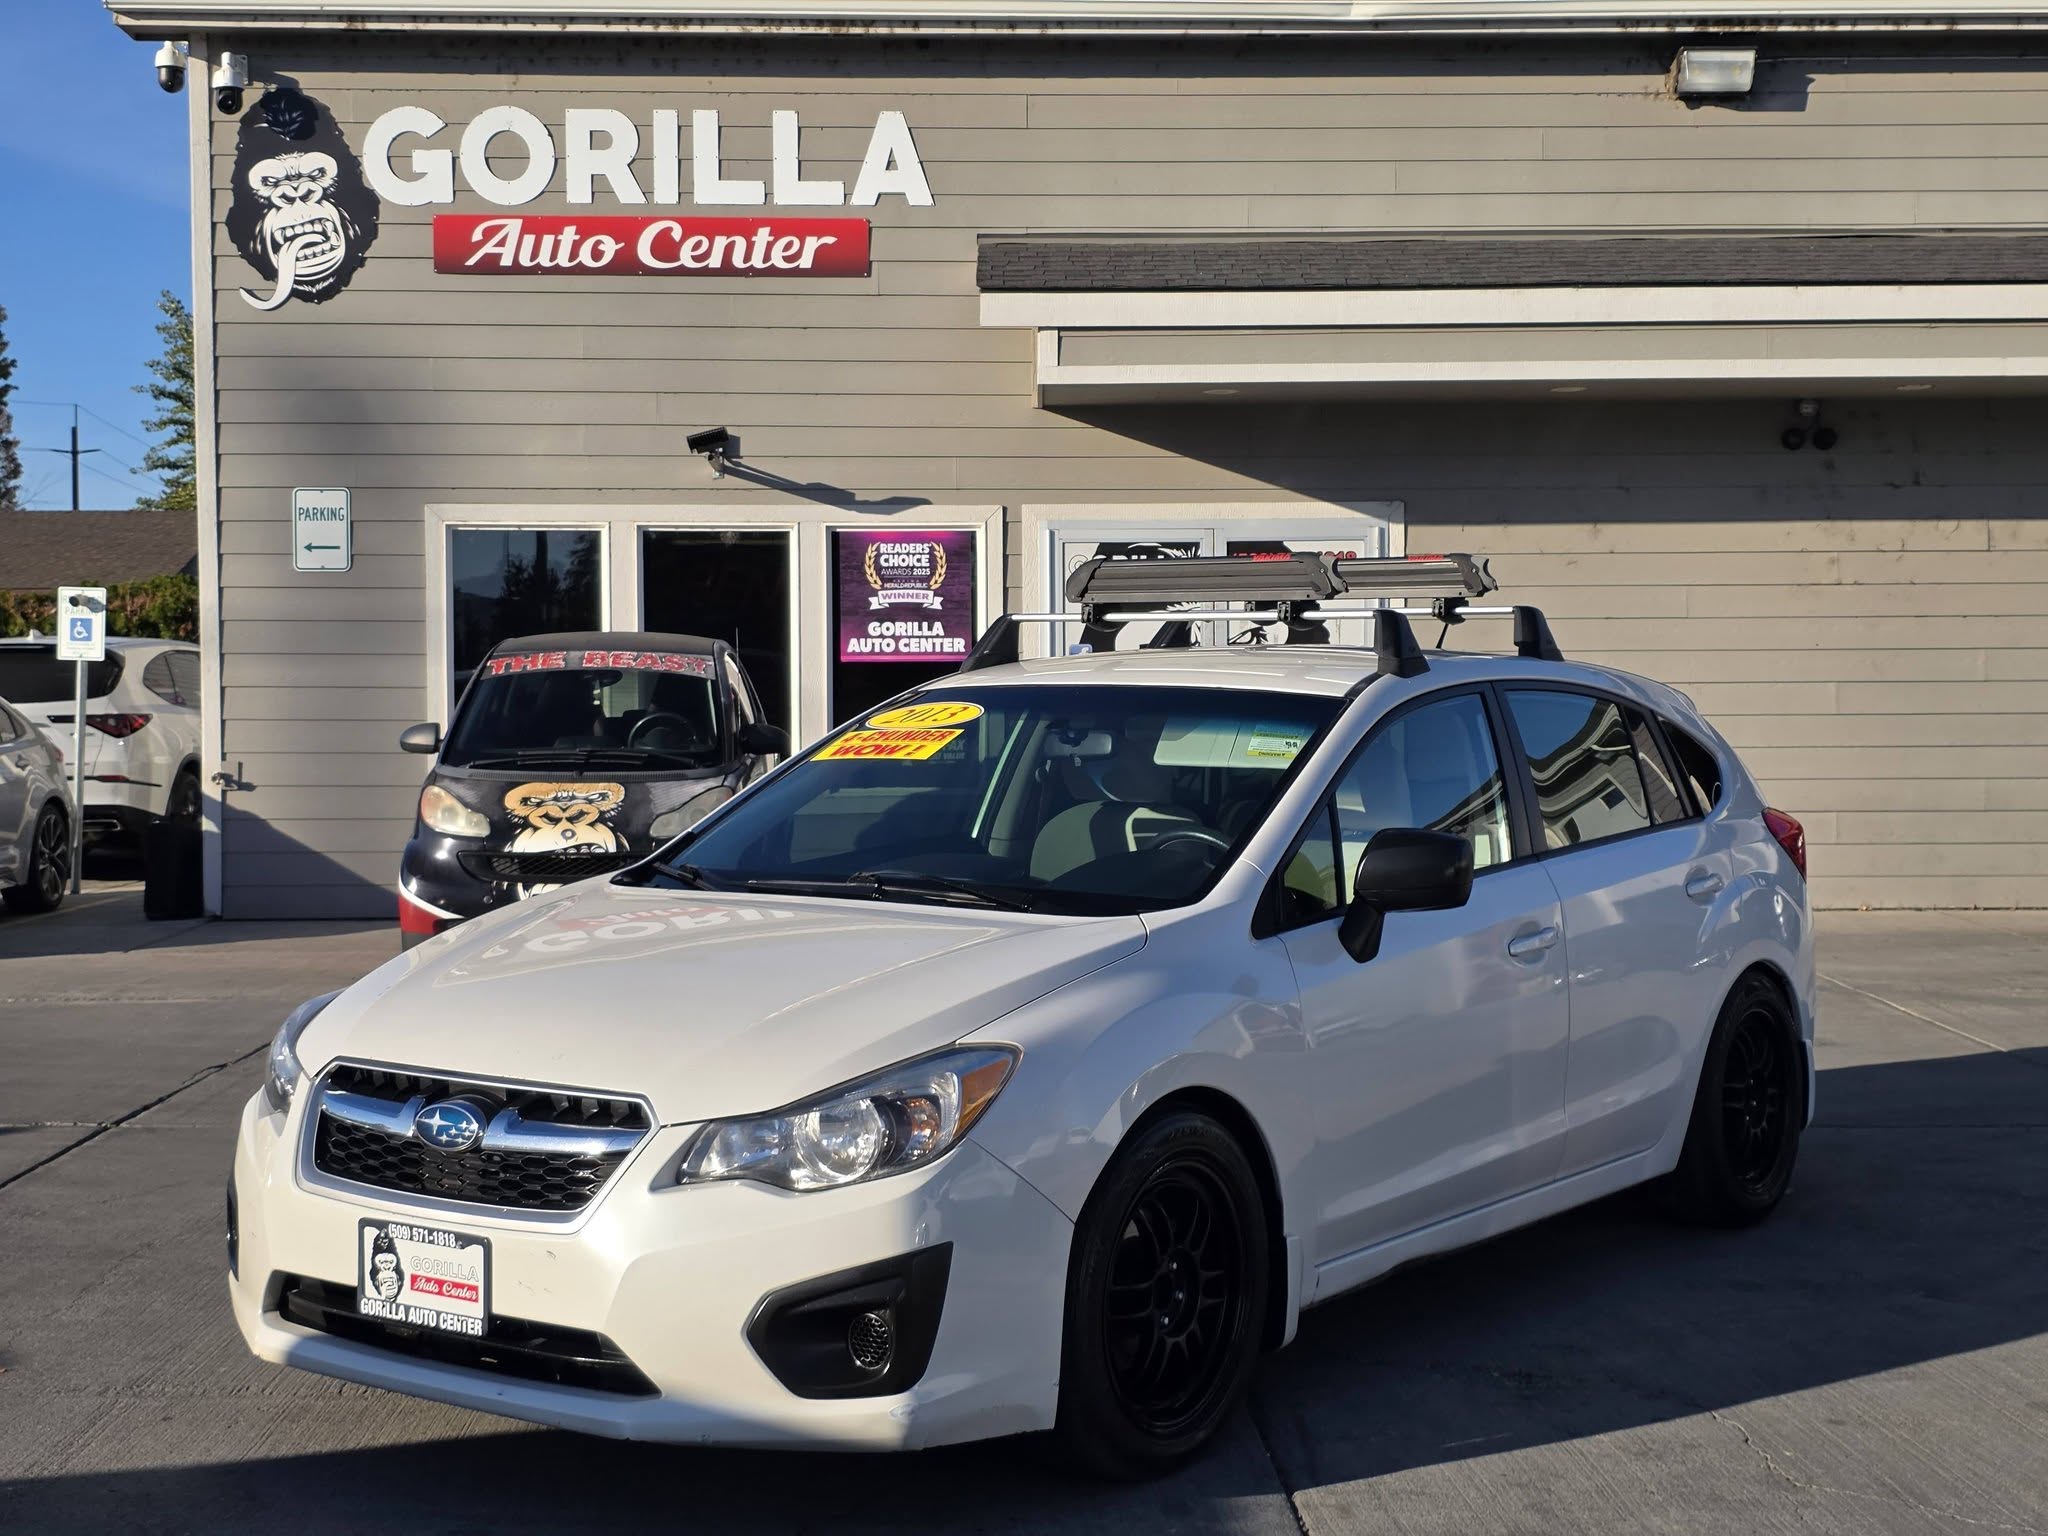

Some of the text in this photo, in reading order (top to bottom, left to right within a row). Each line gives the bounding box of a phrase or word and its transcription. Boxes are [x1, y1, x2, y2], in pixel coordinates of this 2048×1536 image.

[363, 106, 935, 208] GORILLA
[465, 218, 838, 270] Auto Center
[298, 507, 345, 521] PARKING
[879, 554, 930, 567] CHOICE
[881, 591, 930, 600] WINNER
[867, 621, 945, 636] GORILLA
[847, 638, 966, 653] AUTO CENTER
[486, 650, 713, 676] THE BEAST
[880, 706, 970, 724] 2013
[840, 730, 957, 743] 4-CYLINDER
[388, 1223, 456, 1248] (509) 571-1818
[410, 1256, 479, 1282] GORILLA
[413, 1276, 478, 1301] Auto Center
[360, 1298, 483, 1337] GORILLA AUTO CENTER
